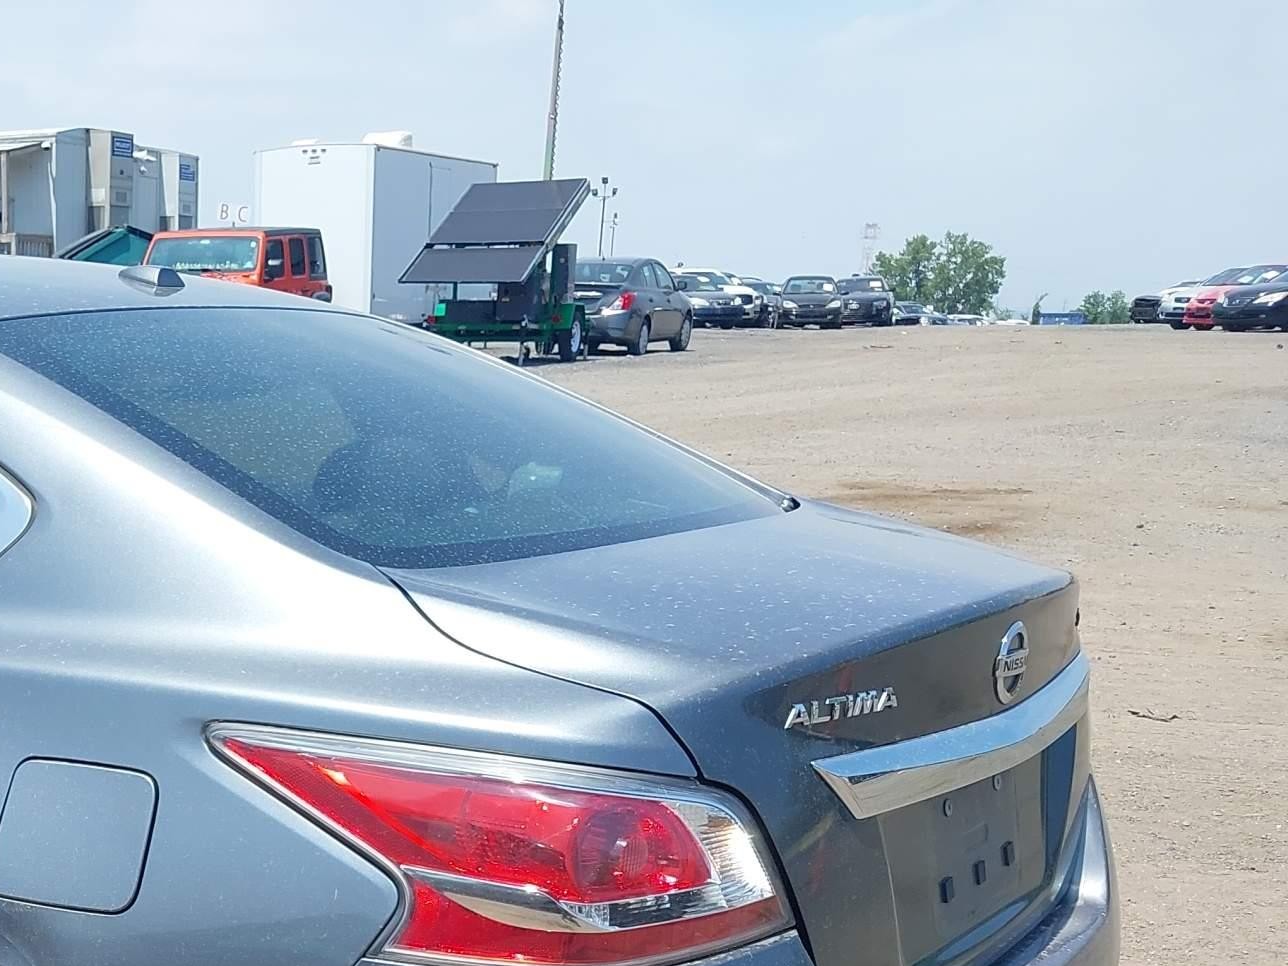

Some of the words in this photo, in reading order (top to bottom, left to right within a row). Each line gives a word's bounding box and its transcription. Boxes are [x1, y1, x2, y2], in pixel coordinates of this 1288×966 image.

[219, 203, 229, 220] B
[238, 206, 249, 222] C
[784, 687, 898, 729] ALTIMA
